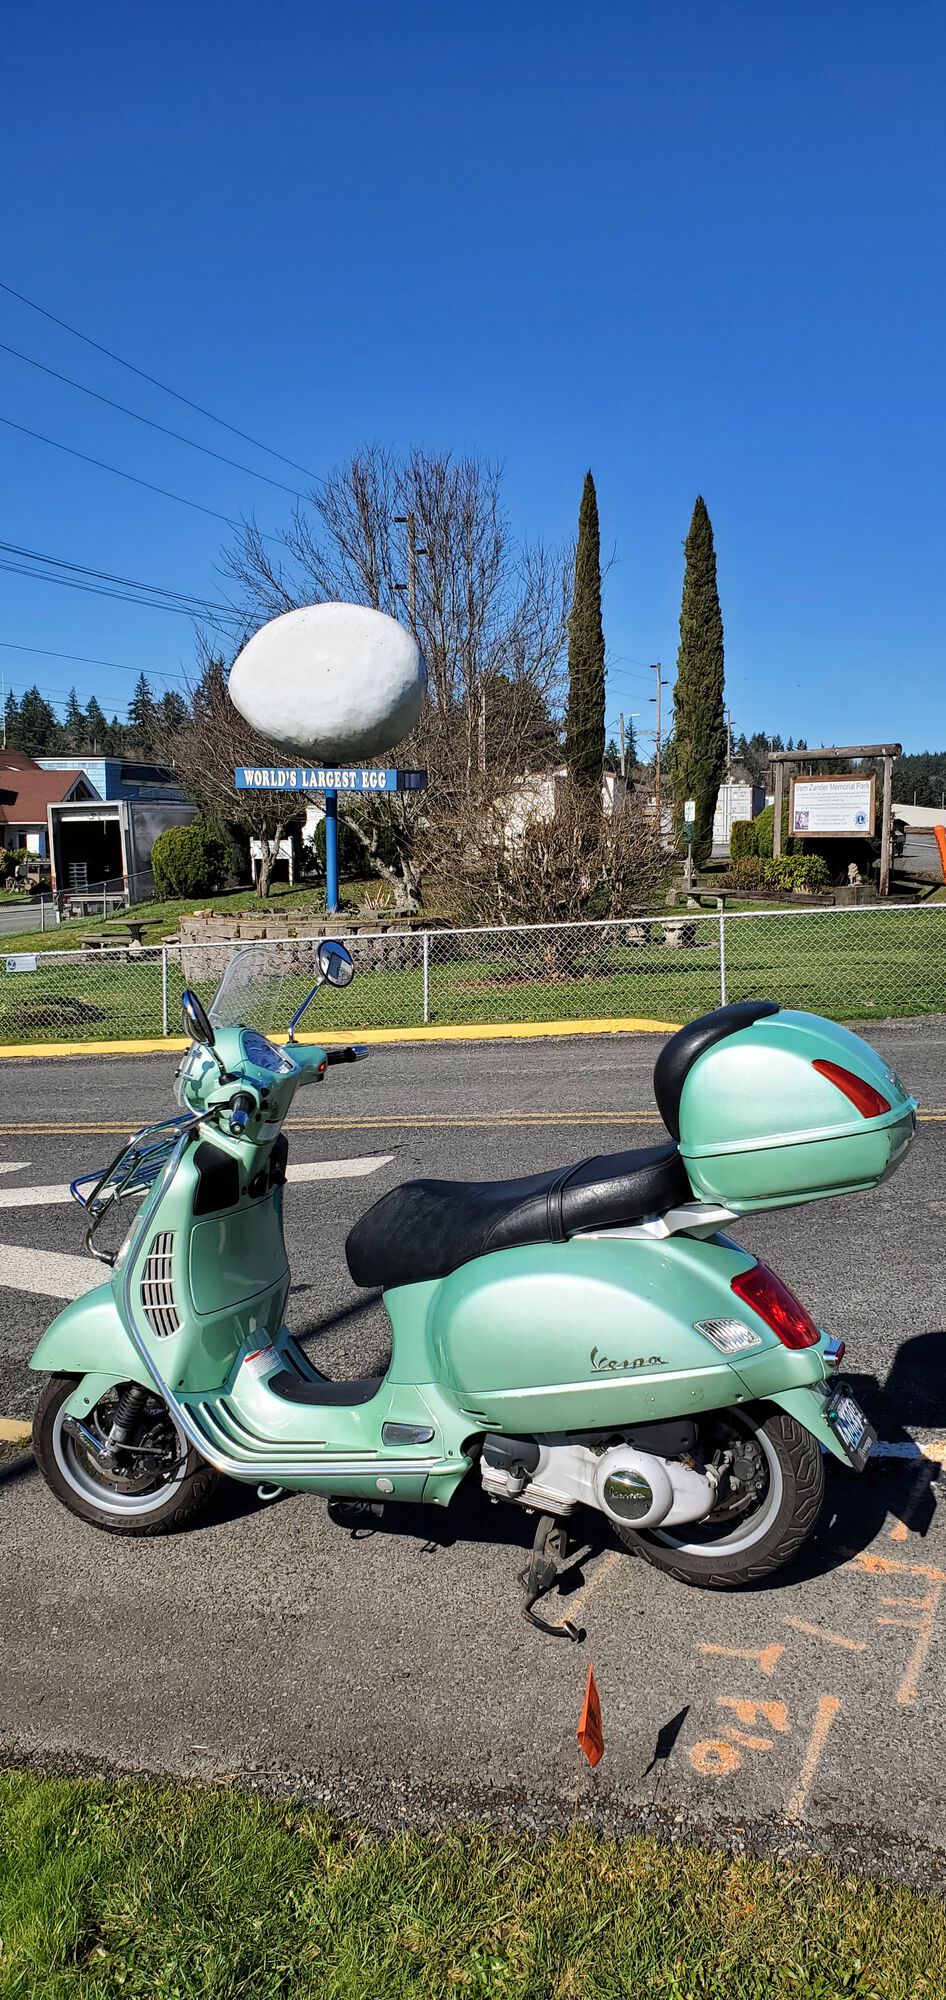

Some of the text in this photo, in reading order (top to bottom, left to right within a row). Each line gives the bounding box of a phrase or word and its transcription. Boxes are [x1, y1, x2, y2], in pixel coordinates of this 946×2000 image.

[243, 769, 387, 789] WORLD'S LARGEST EGG
[809, 783, 829, 792] Zander
[829, 782, 855, 791] Memorial
[856, 782, 870, 790] Park
[590, 1345, 669, 1373] Vespa
